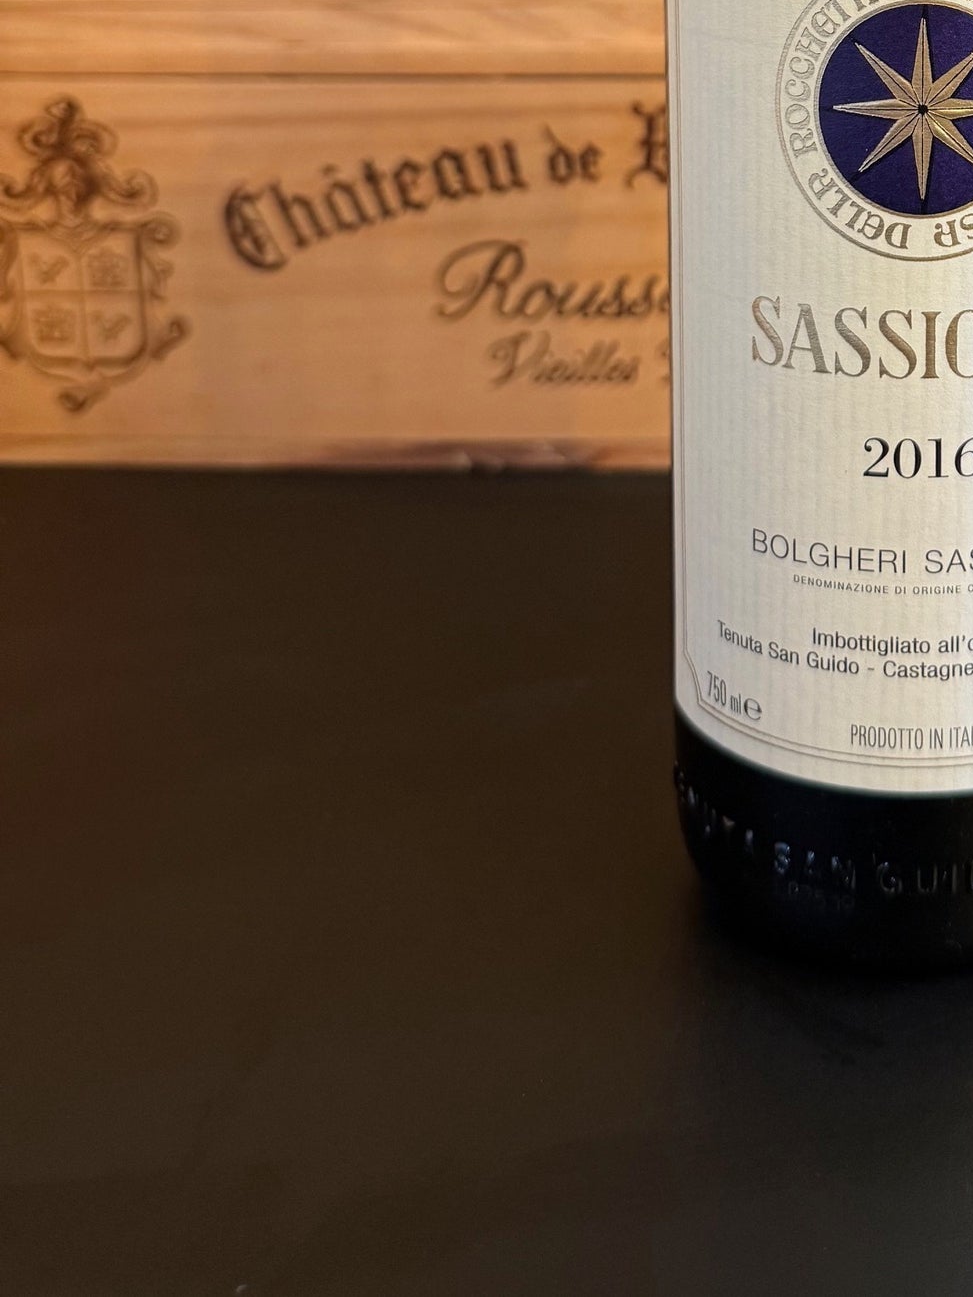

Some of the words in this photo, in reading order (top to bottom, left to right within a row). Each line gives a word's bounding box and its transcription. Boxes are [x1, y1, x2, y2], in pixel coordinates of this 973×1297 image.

[222, 135, 530, 274] Château
[542, 125, 606, 187] de
[752, 527, 907, 575] BOLGHERI
[793, 574, 889, 595] DENOMINAZIONE
[894, 586, 907, 595] DI
[912, 585, 962, 595] ORIGINE
[717, 619, 763, 655] Tenuta
[768, 641, 800, 665] San
[806, 651, 860, 675] Guido
[812, 627, 931, 656] Imbottigliato
[707, 670, 727, 707] 750
[851, 724, 924, 752] PRODOTTO
[929, 727, 944, 750] IN
